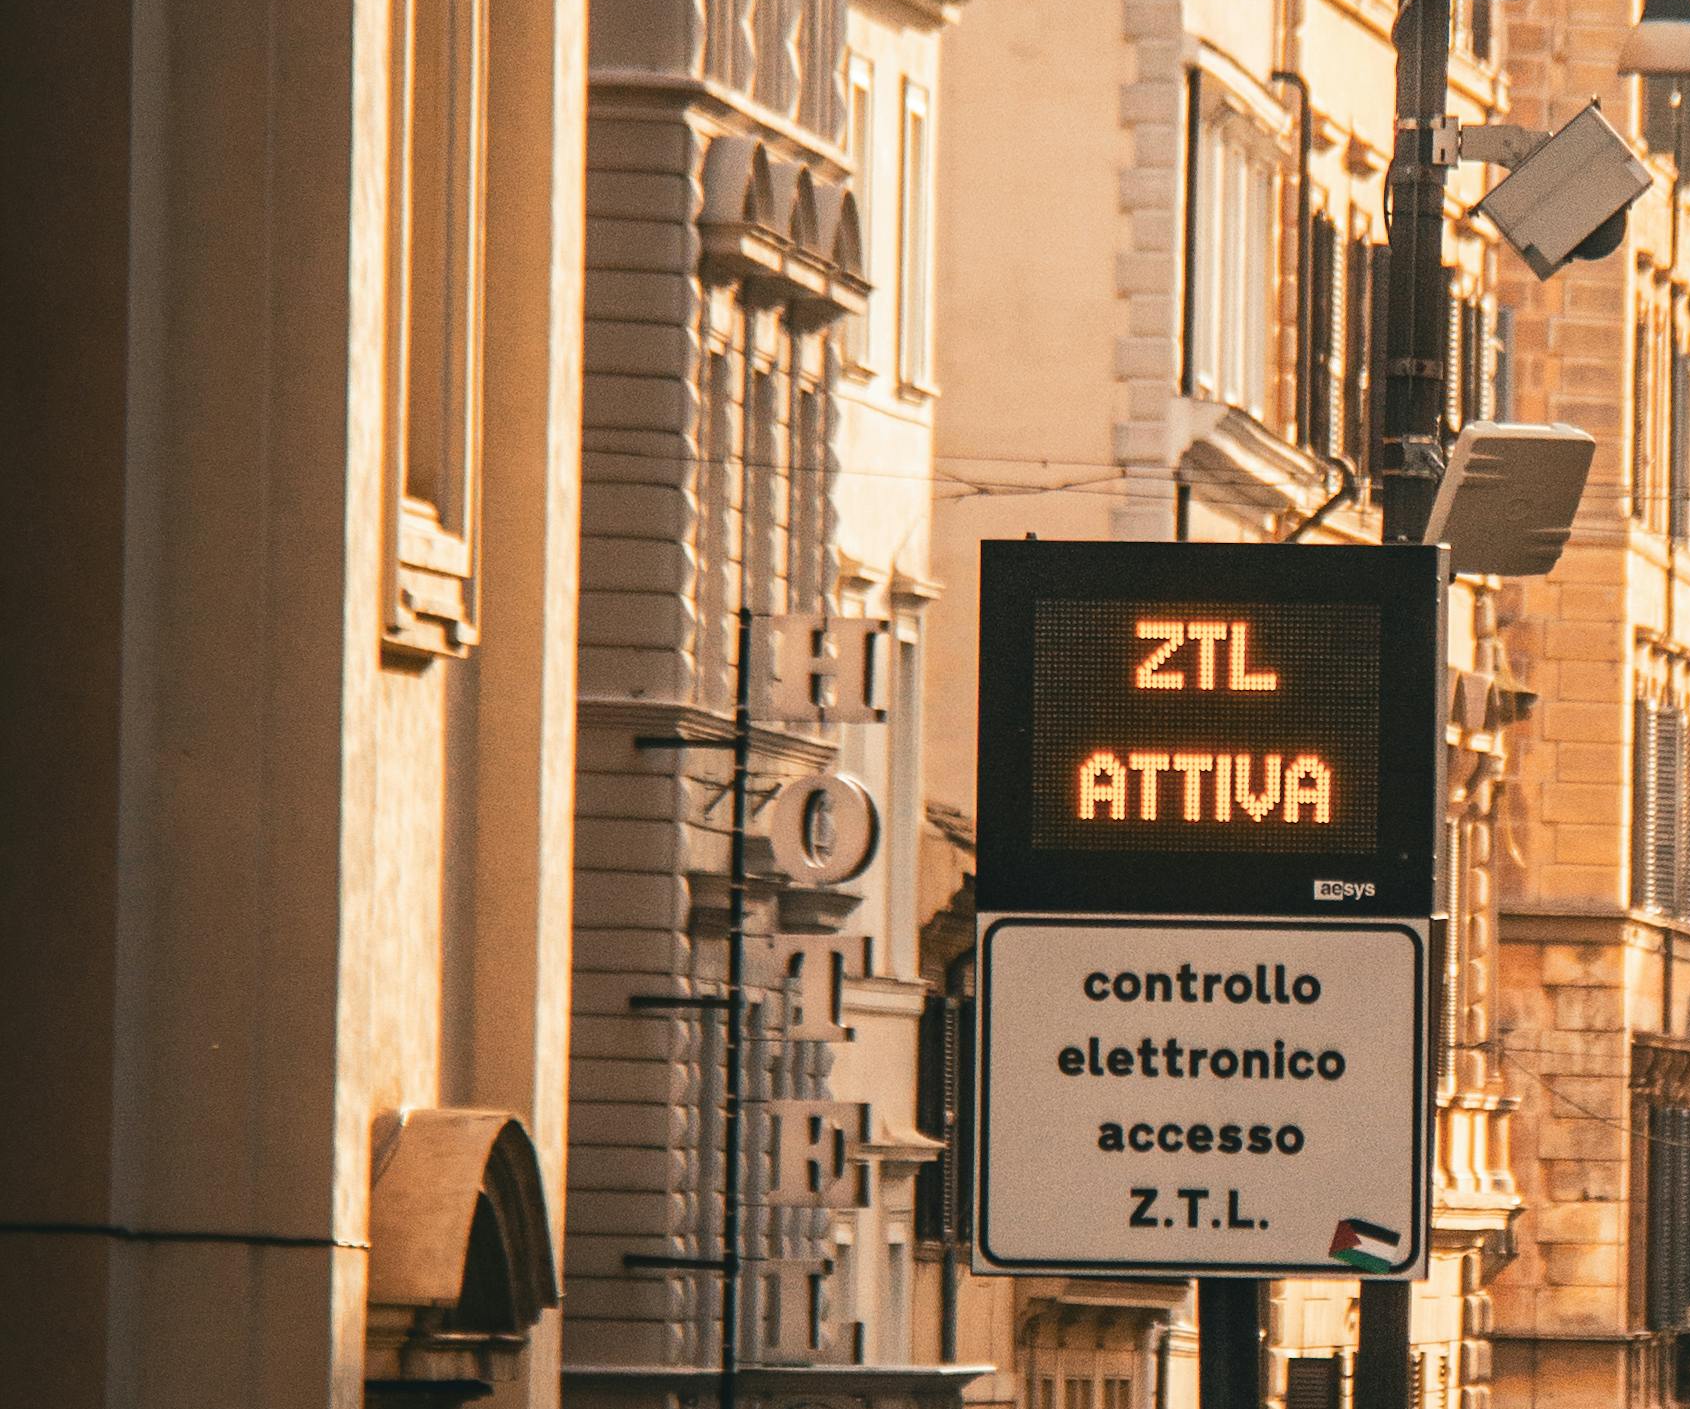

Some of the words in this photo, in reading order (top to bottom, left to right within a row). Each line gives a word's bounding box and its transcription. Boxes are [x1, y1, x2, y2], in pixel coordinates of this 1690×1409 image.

[1135, 619, 1278, 692] ZTL
[1077, 751, 1332, 825] ATTIVA
[1319, 881, 1377, 901] aesys
[750, 616, 890, 1367] HOTEL
[1083, 964, 1322, 1005] controllo
[1057, 1037, 1346, 1081] elettronico
[1097, 1119, 1305, 1155] accesso
[1129, 1188, 1270, 1230] Z.T.L.
